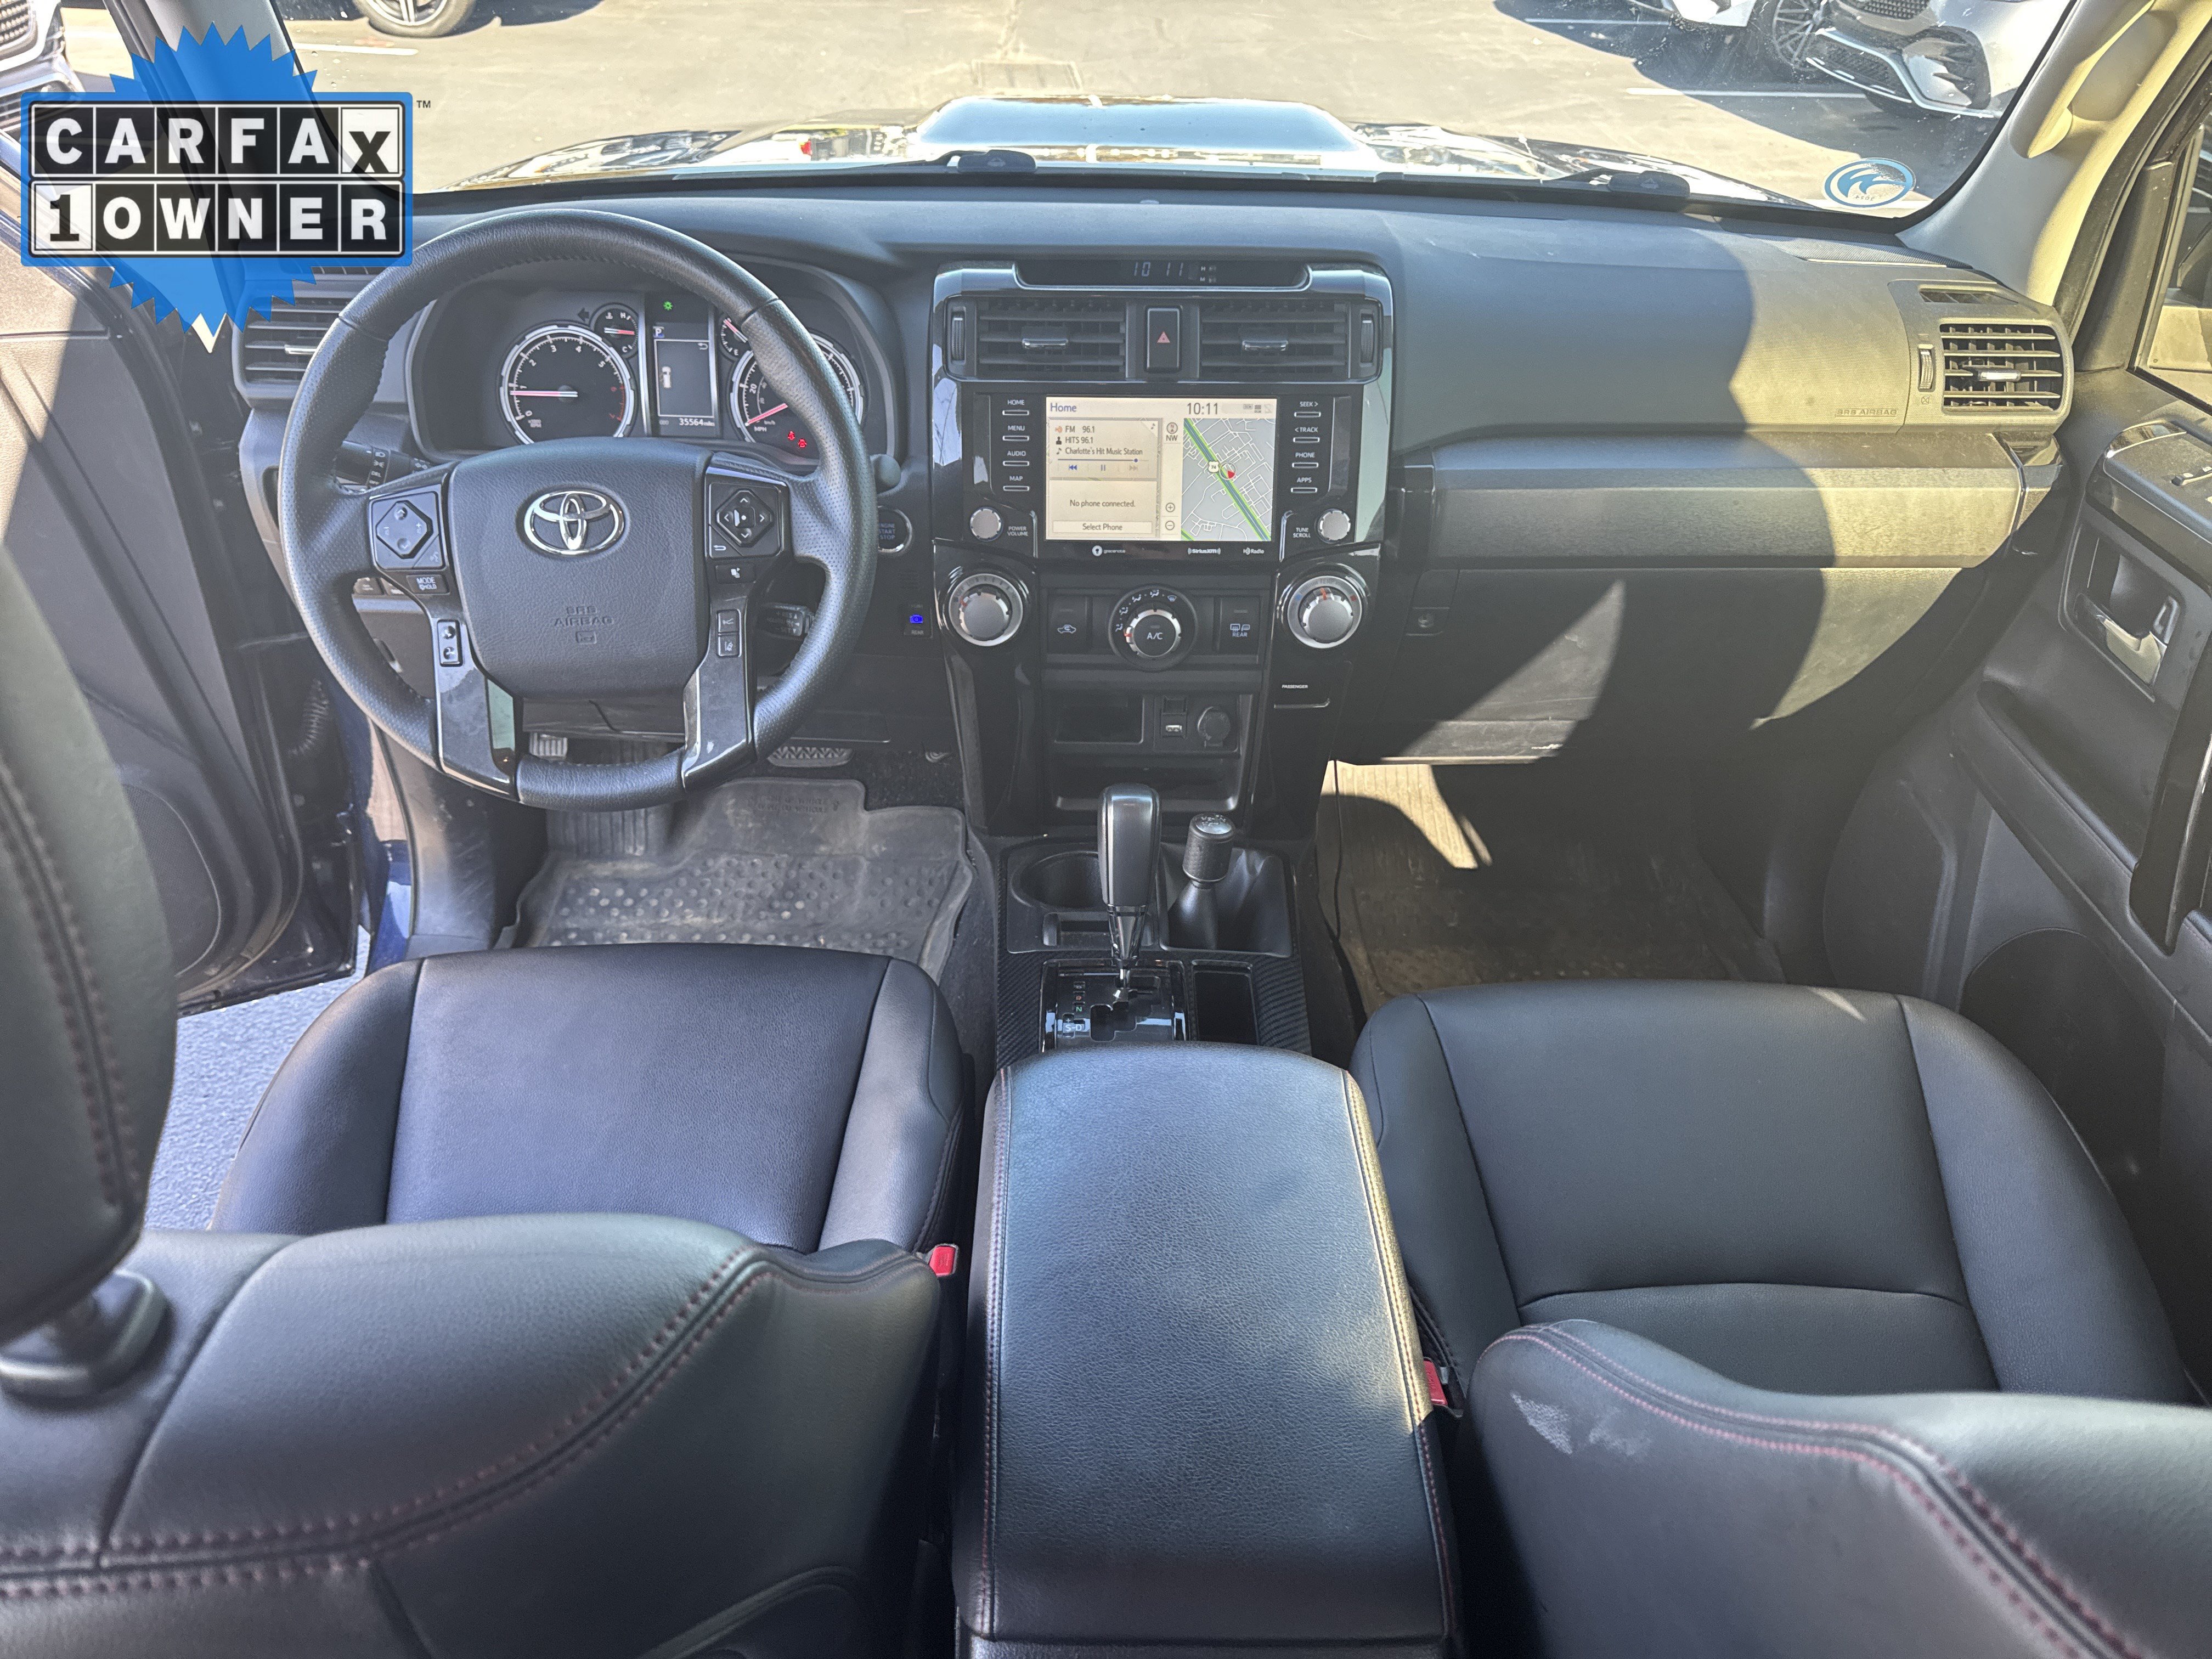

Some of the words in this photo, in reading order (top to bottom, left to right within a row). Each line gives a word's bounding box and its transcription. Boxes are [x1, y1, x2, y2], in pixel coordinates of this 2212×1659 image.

[749, 384, 757, 394] 20
[1050, 403, 1077, 412] Home
[1187, 403, 1218, 415] 10:11
[679, 417, 704, 426] 35564
[1065, 447, 1094, 455] Charlotte's
[416, 577, 436, 585] MODE
[554, 616, 614, 627] AIRBAG
[1147, 632, 1163, 640] A/C
